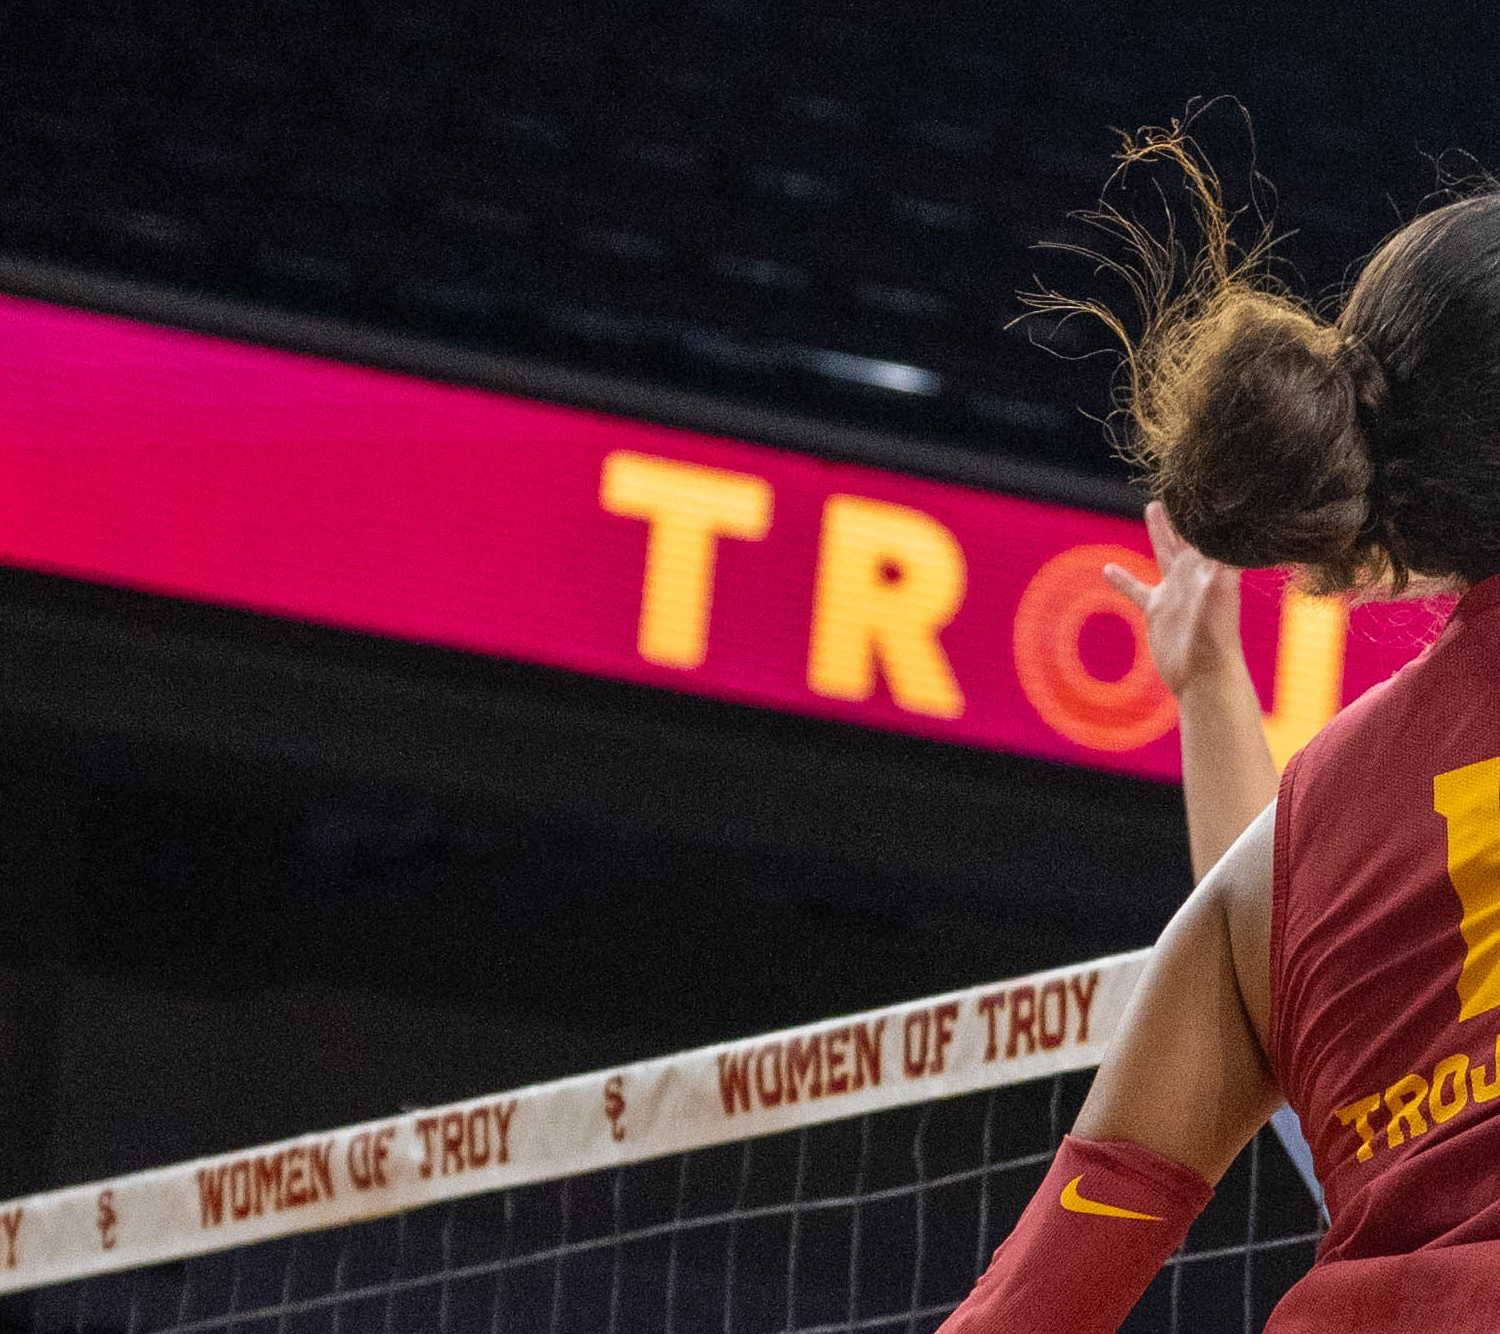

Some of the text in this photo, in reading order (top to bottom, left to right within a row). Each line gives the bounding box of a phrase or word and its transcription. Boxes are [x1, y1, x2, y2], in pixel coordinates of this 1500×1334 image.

[717, 970, 1100, 1116] WOMEN OF TROY
[197, 1099, 518, 1230] WOMEN OF TROY
